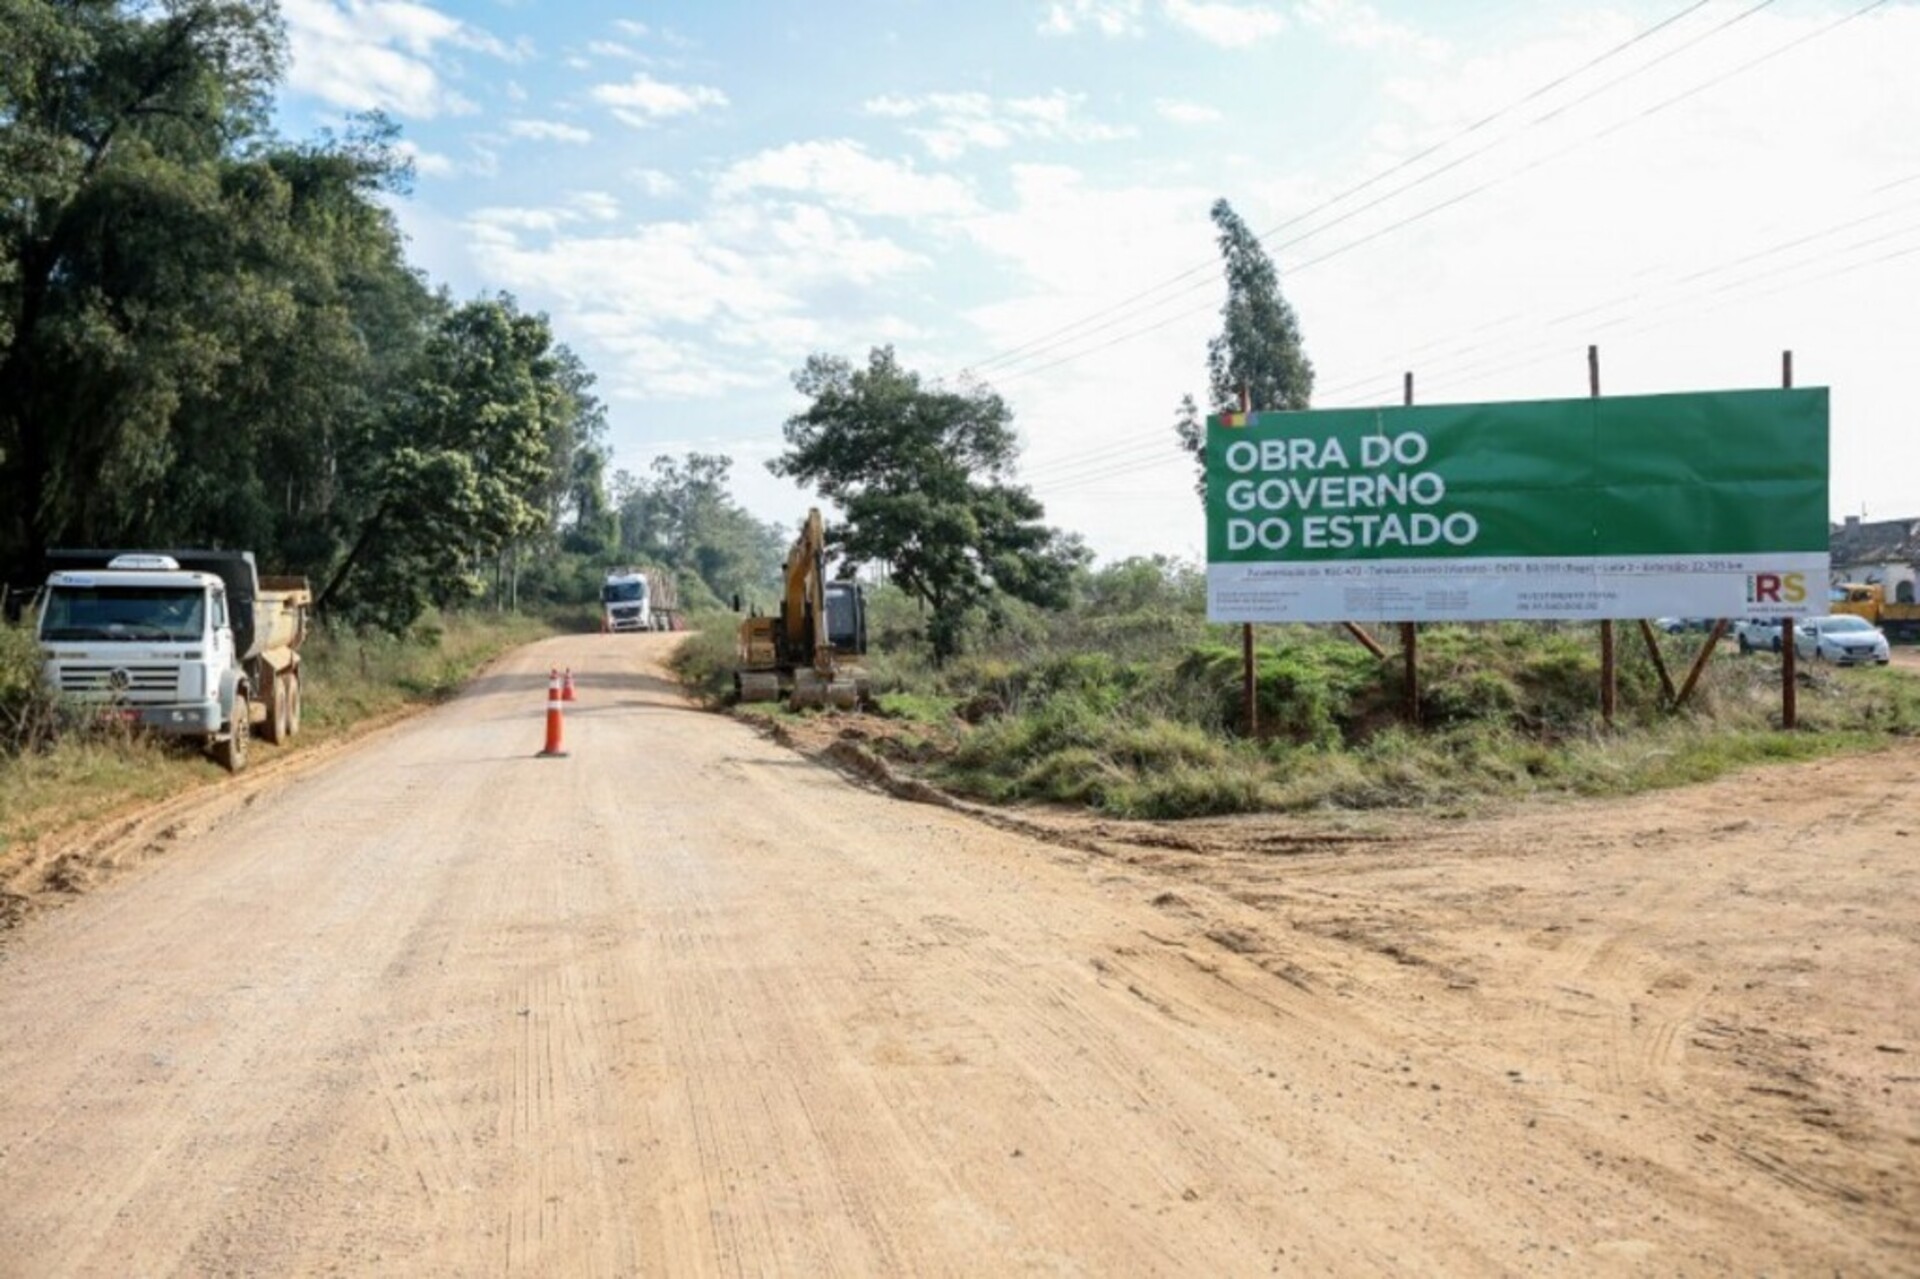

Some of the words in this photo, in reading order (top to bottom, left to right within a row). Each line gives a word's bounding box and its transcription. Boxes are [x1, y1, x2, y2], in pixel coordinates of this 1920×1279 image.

[1225, 437, 1349, 473] OBRA
[1361, 431, 1428, 468] DO
[1226, 472, 1445, 511] GOVERNO
[1228, 517, 1291, 550] DO
[1303, 512, 1479, 549] ESTADO
[1756, 571, 1806, 603] RS
